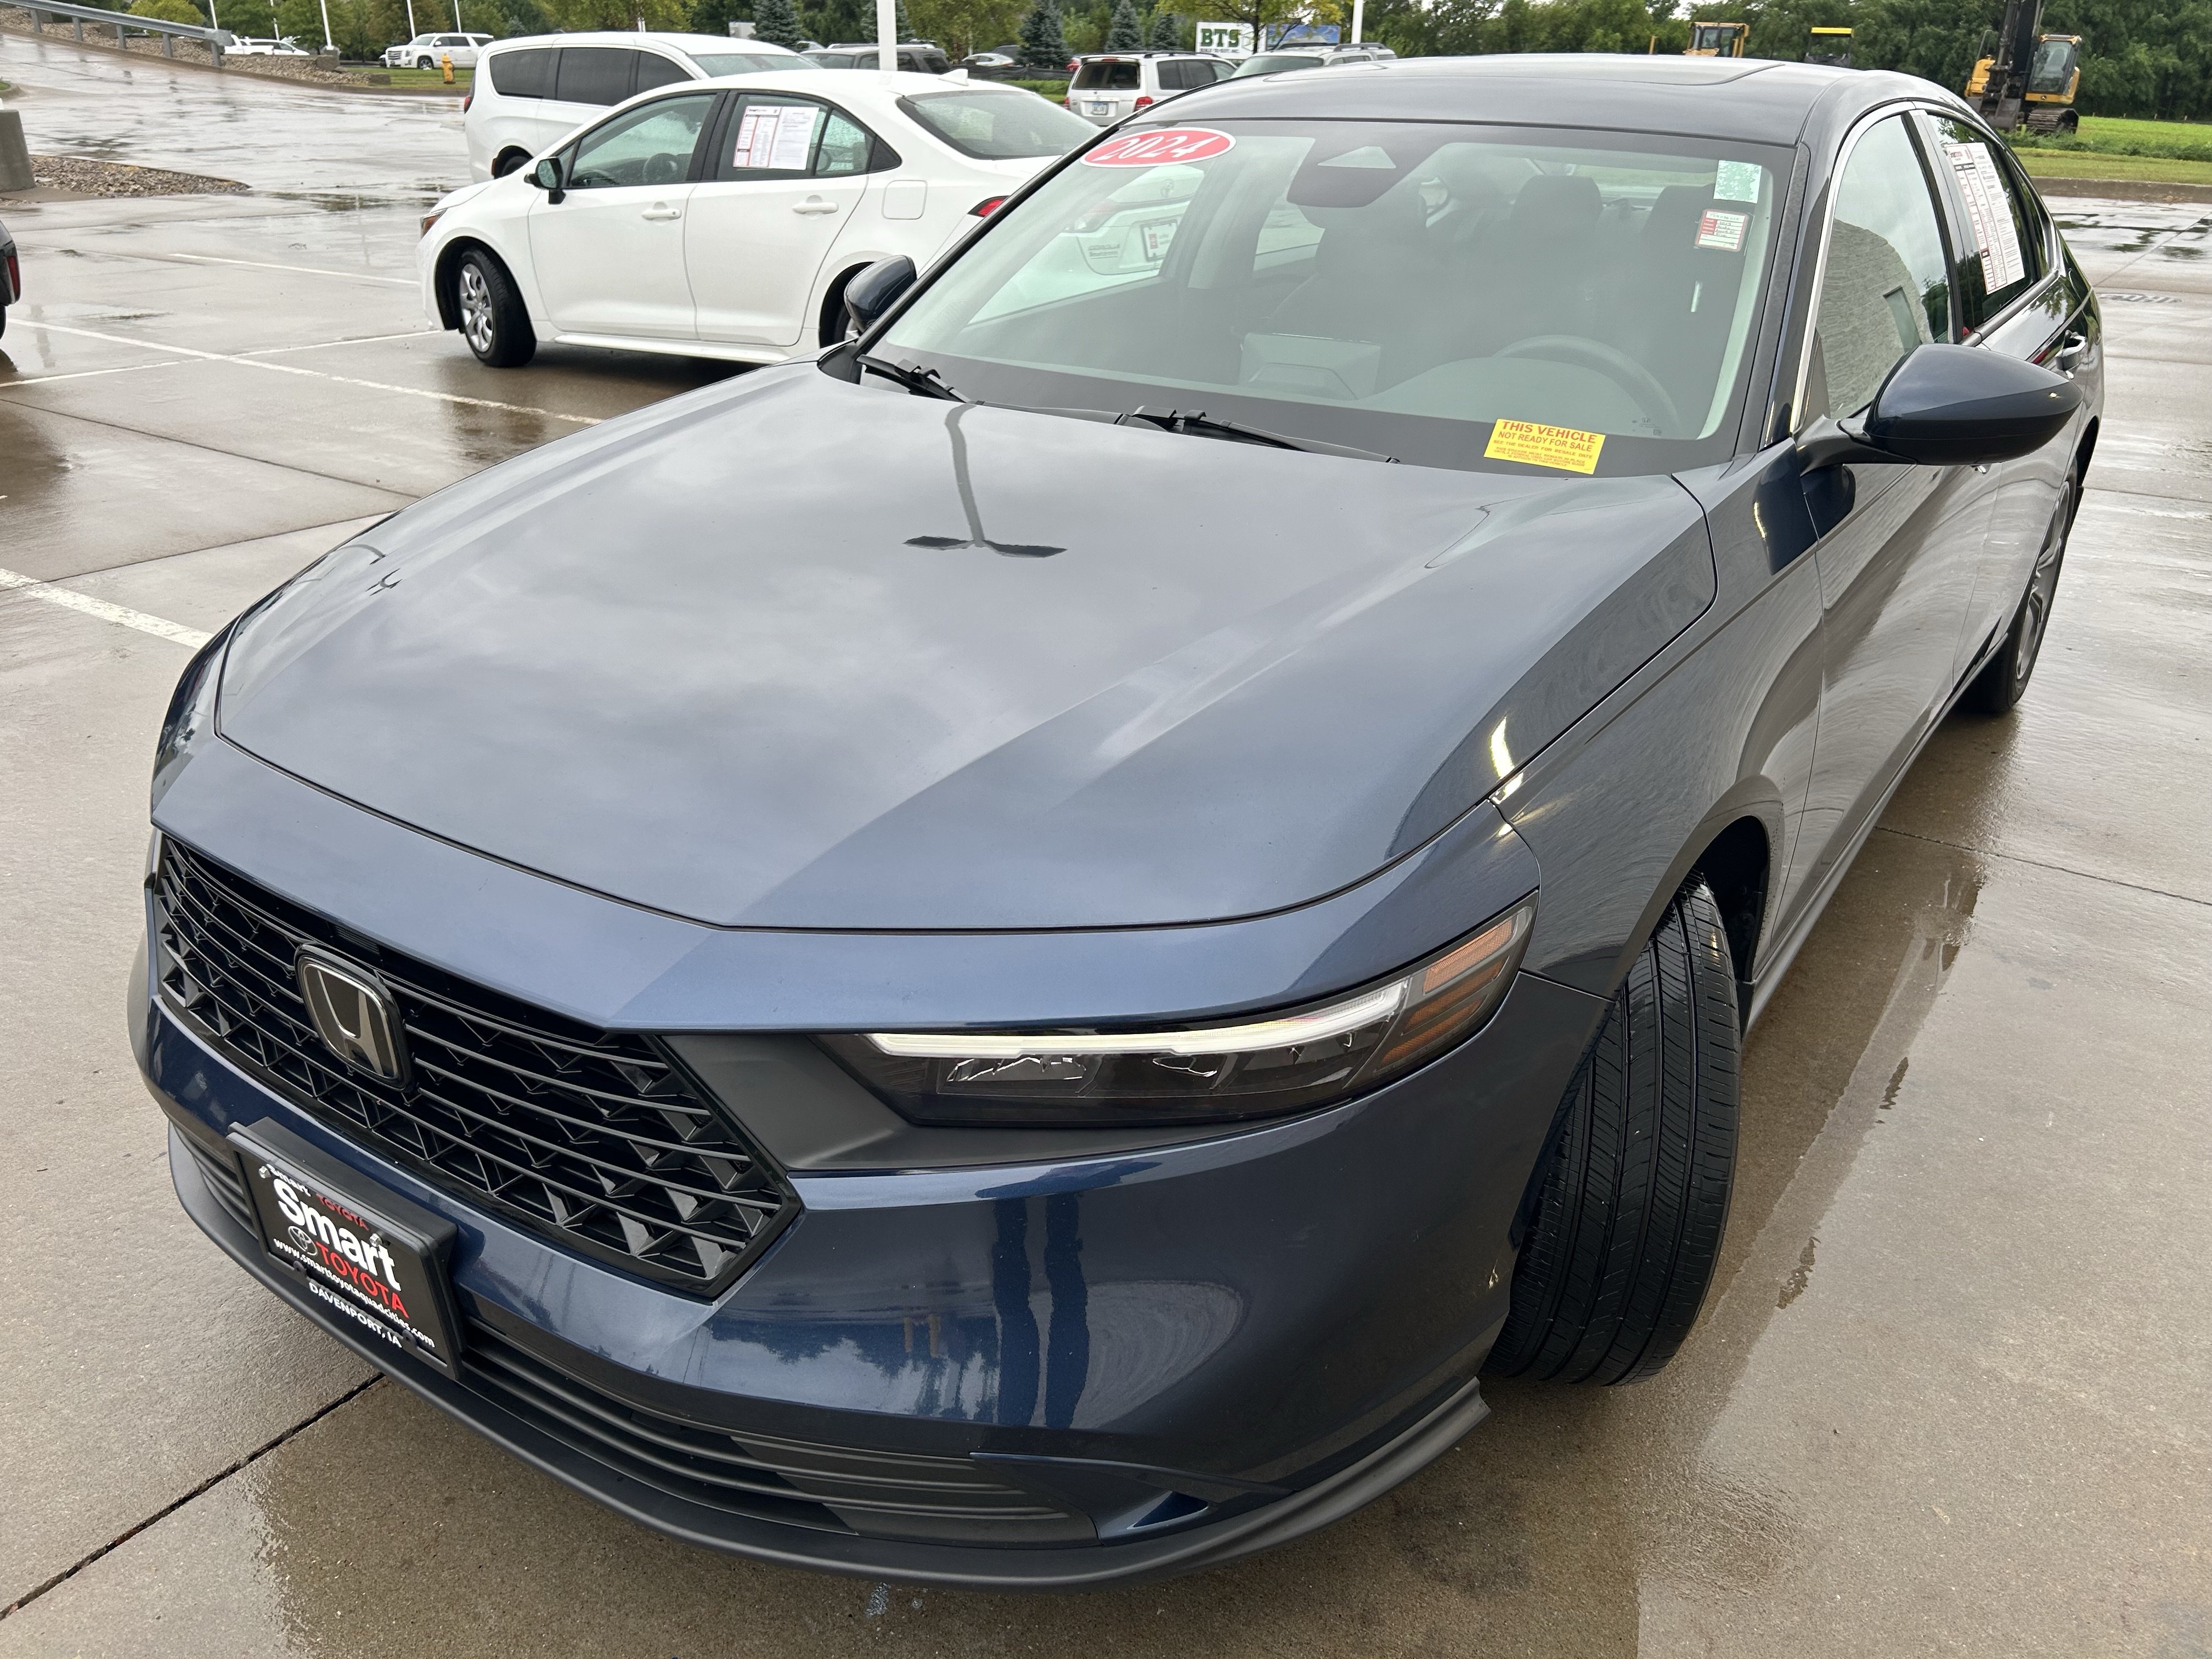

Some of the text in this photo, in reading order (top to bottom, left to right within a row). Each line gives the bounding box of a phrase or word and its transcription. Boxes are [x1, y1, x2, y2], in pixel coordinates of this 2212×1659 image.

[1201, 29, 1239, 47] BTS
[1092, 136, 1221, 162] 2024
[1498, 431, 1593, 452] NOT READY FOR SALE
[1502, 421, 1597, 443] THIS VEHICLE
[267, 1164, 369, 1231] Smart TOYOTA
[273, 1178, 402, 1291] Smart
[273, 1238, 436, 1348] www.smarttoyotaquadcities.com
[315, 1241, 410, 1319] TOYOTA
[308, 1282, 403, 1348] DAVENPORT, IA
